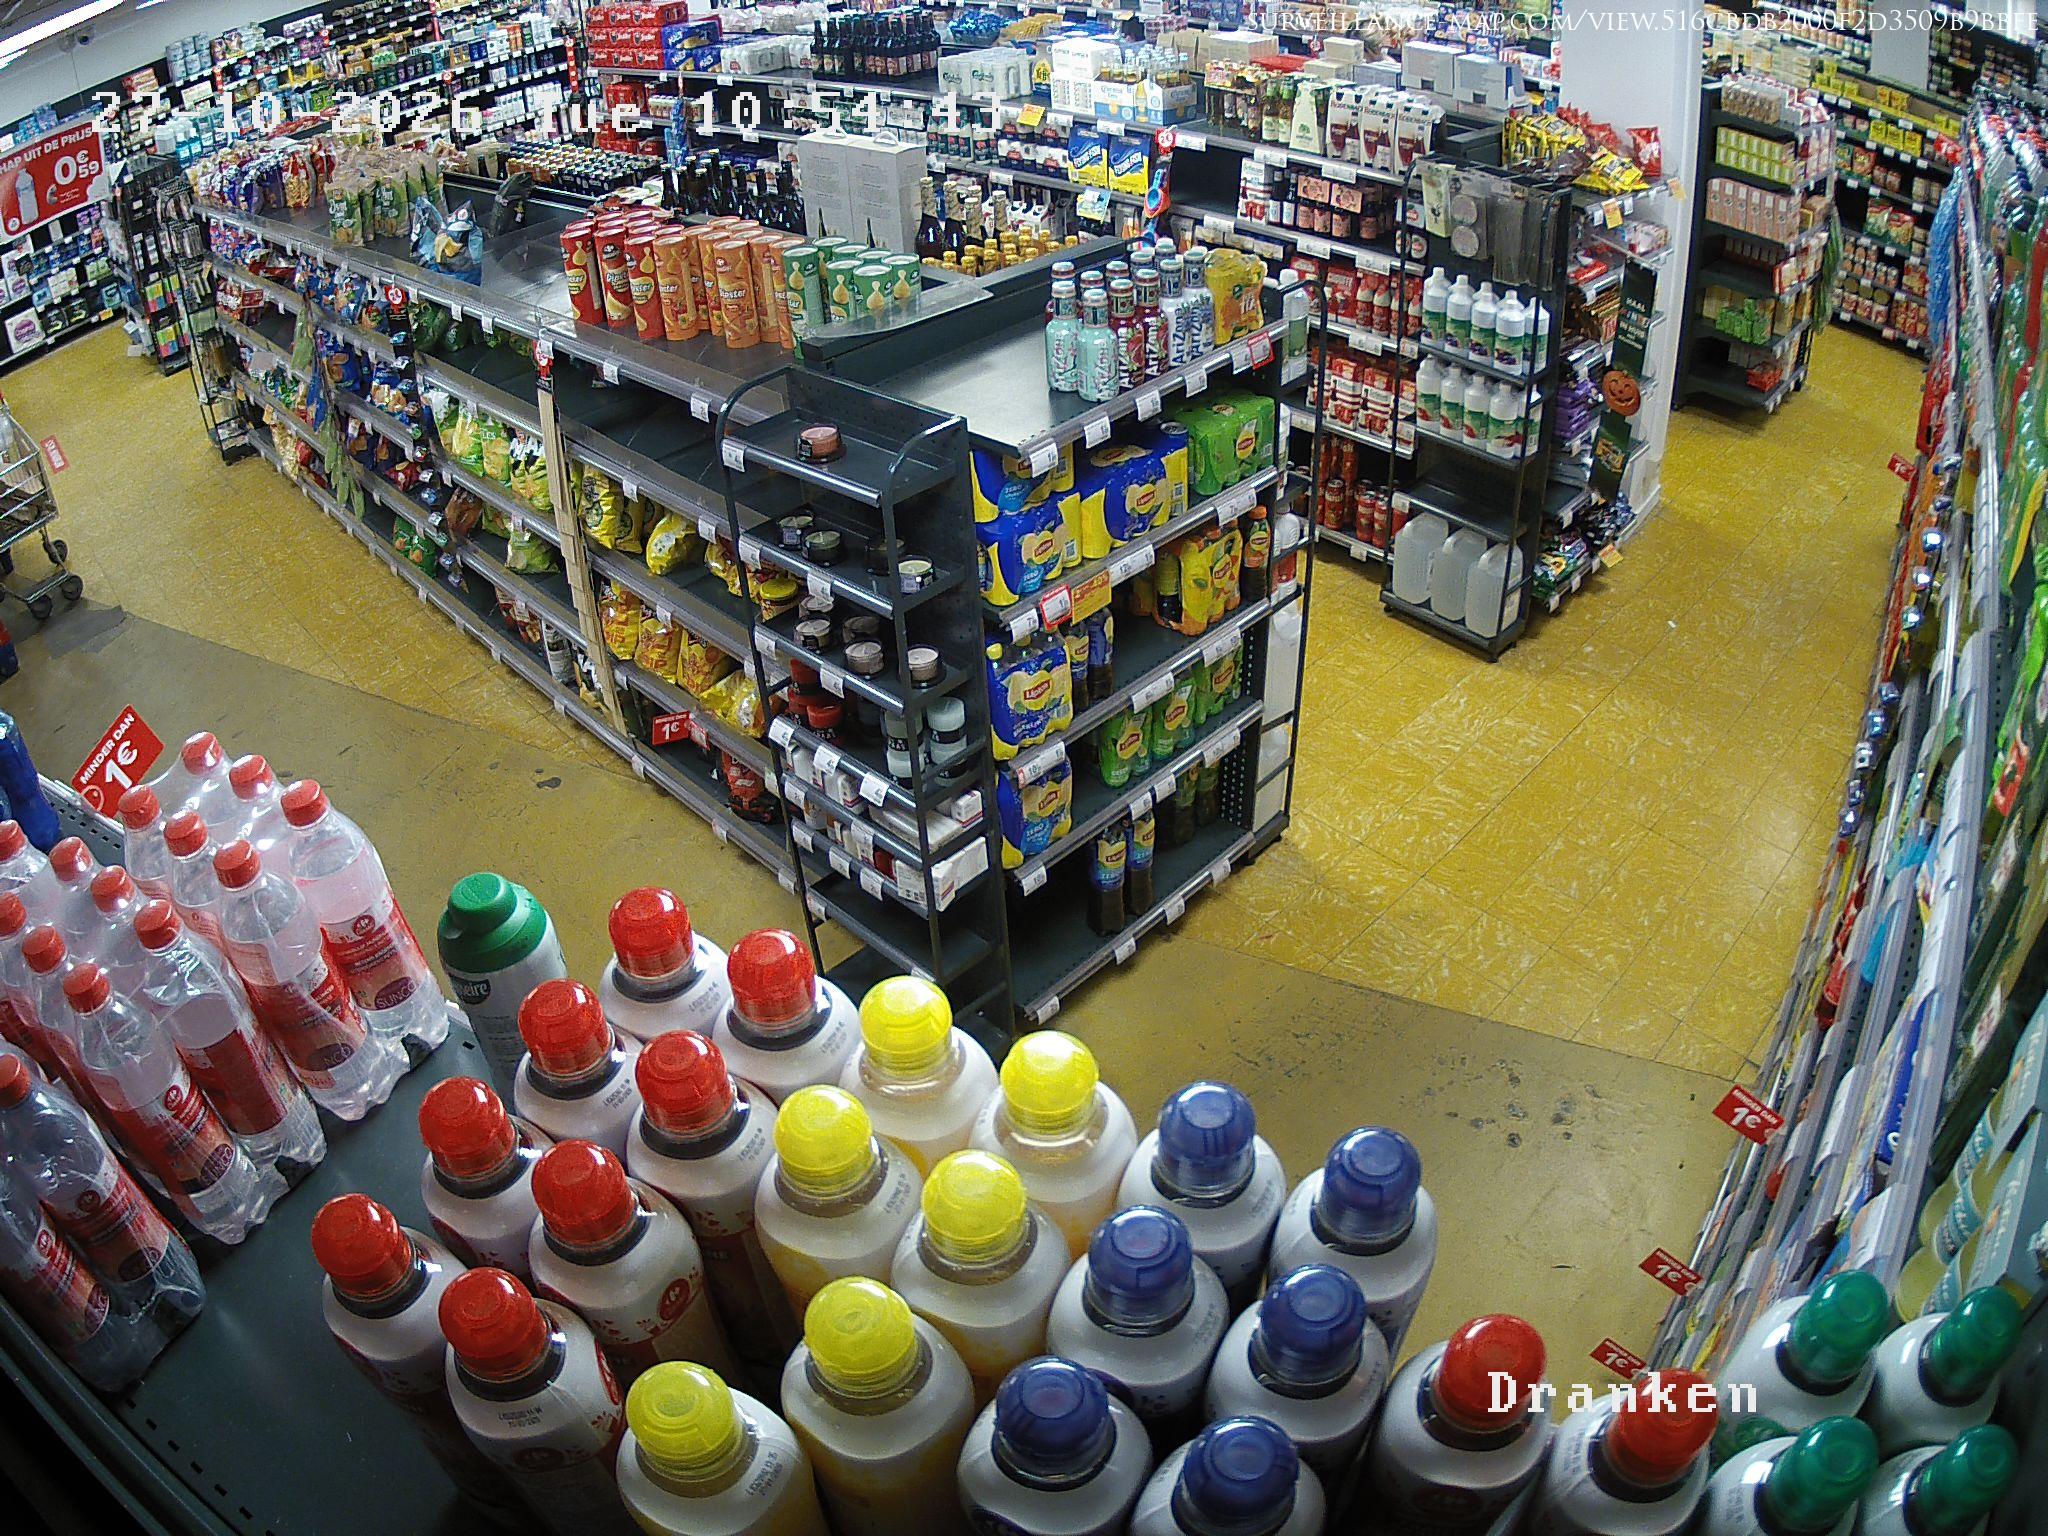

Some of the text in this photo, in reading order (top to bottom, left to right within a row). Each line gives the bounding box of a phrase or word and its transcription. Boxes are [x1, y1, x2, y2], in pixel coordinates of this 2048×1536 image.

[24, 147, 42, 163] UIT
[44, 138, 59, 151] DE
[61, 127, 93, 147] PRIJS
[1022, 679, 1052, 701] Lipton
[80, 713, 135, 785] MINDER DAN
[105, 740, 138, 790] 1€
[1730, 1107, 1763, 1129] 1€
[1654, 1264, 1682, 1282] 1€
[1604, 1352, 1628, 1369] 1€
